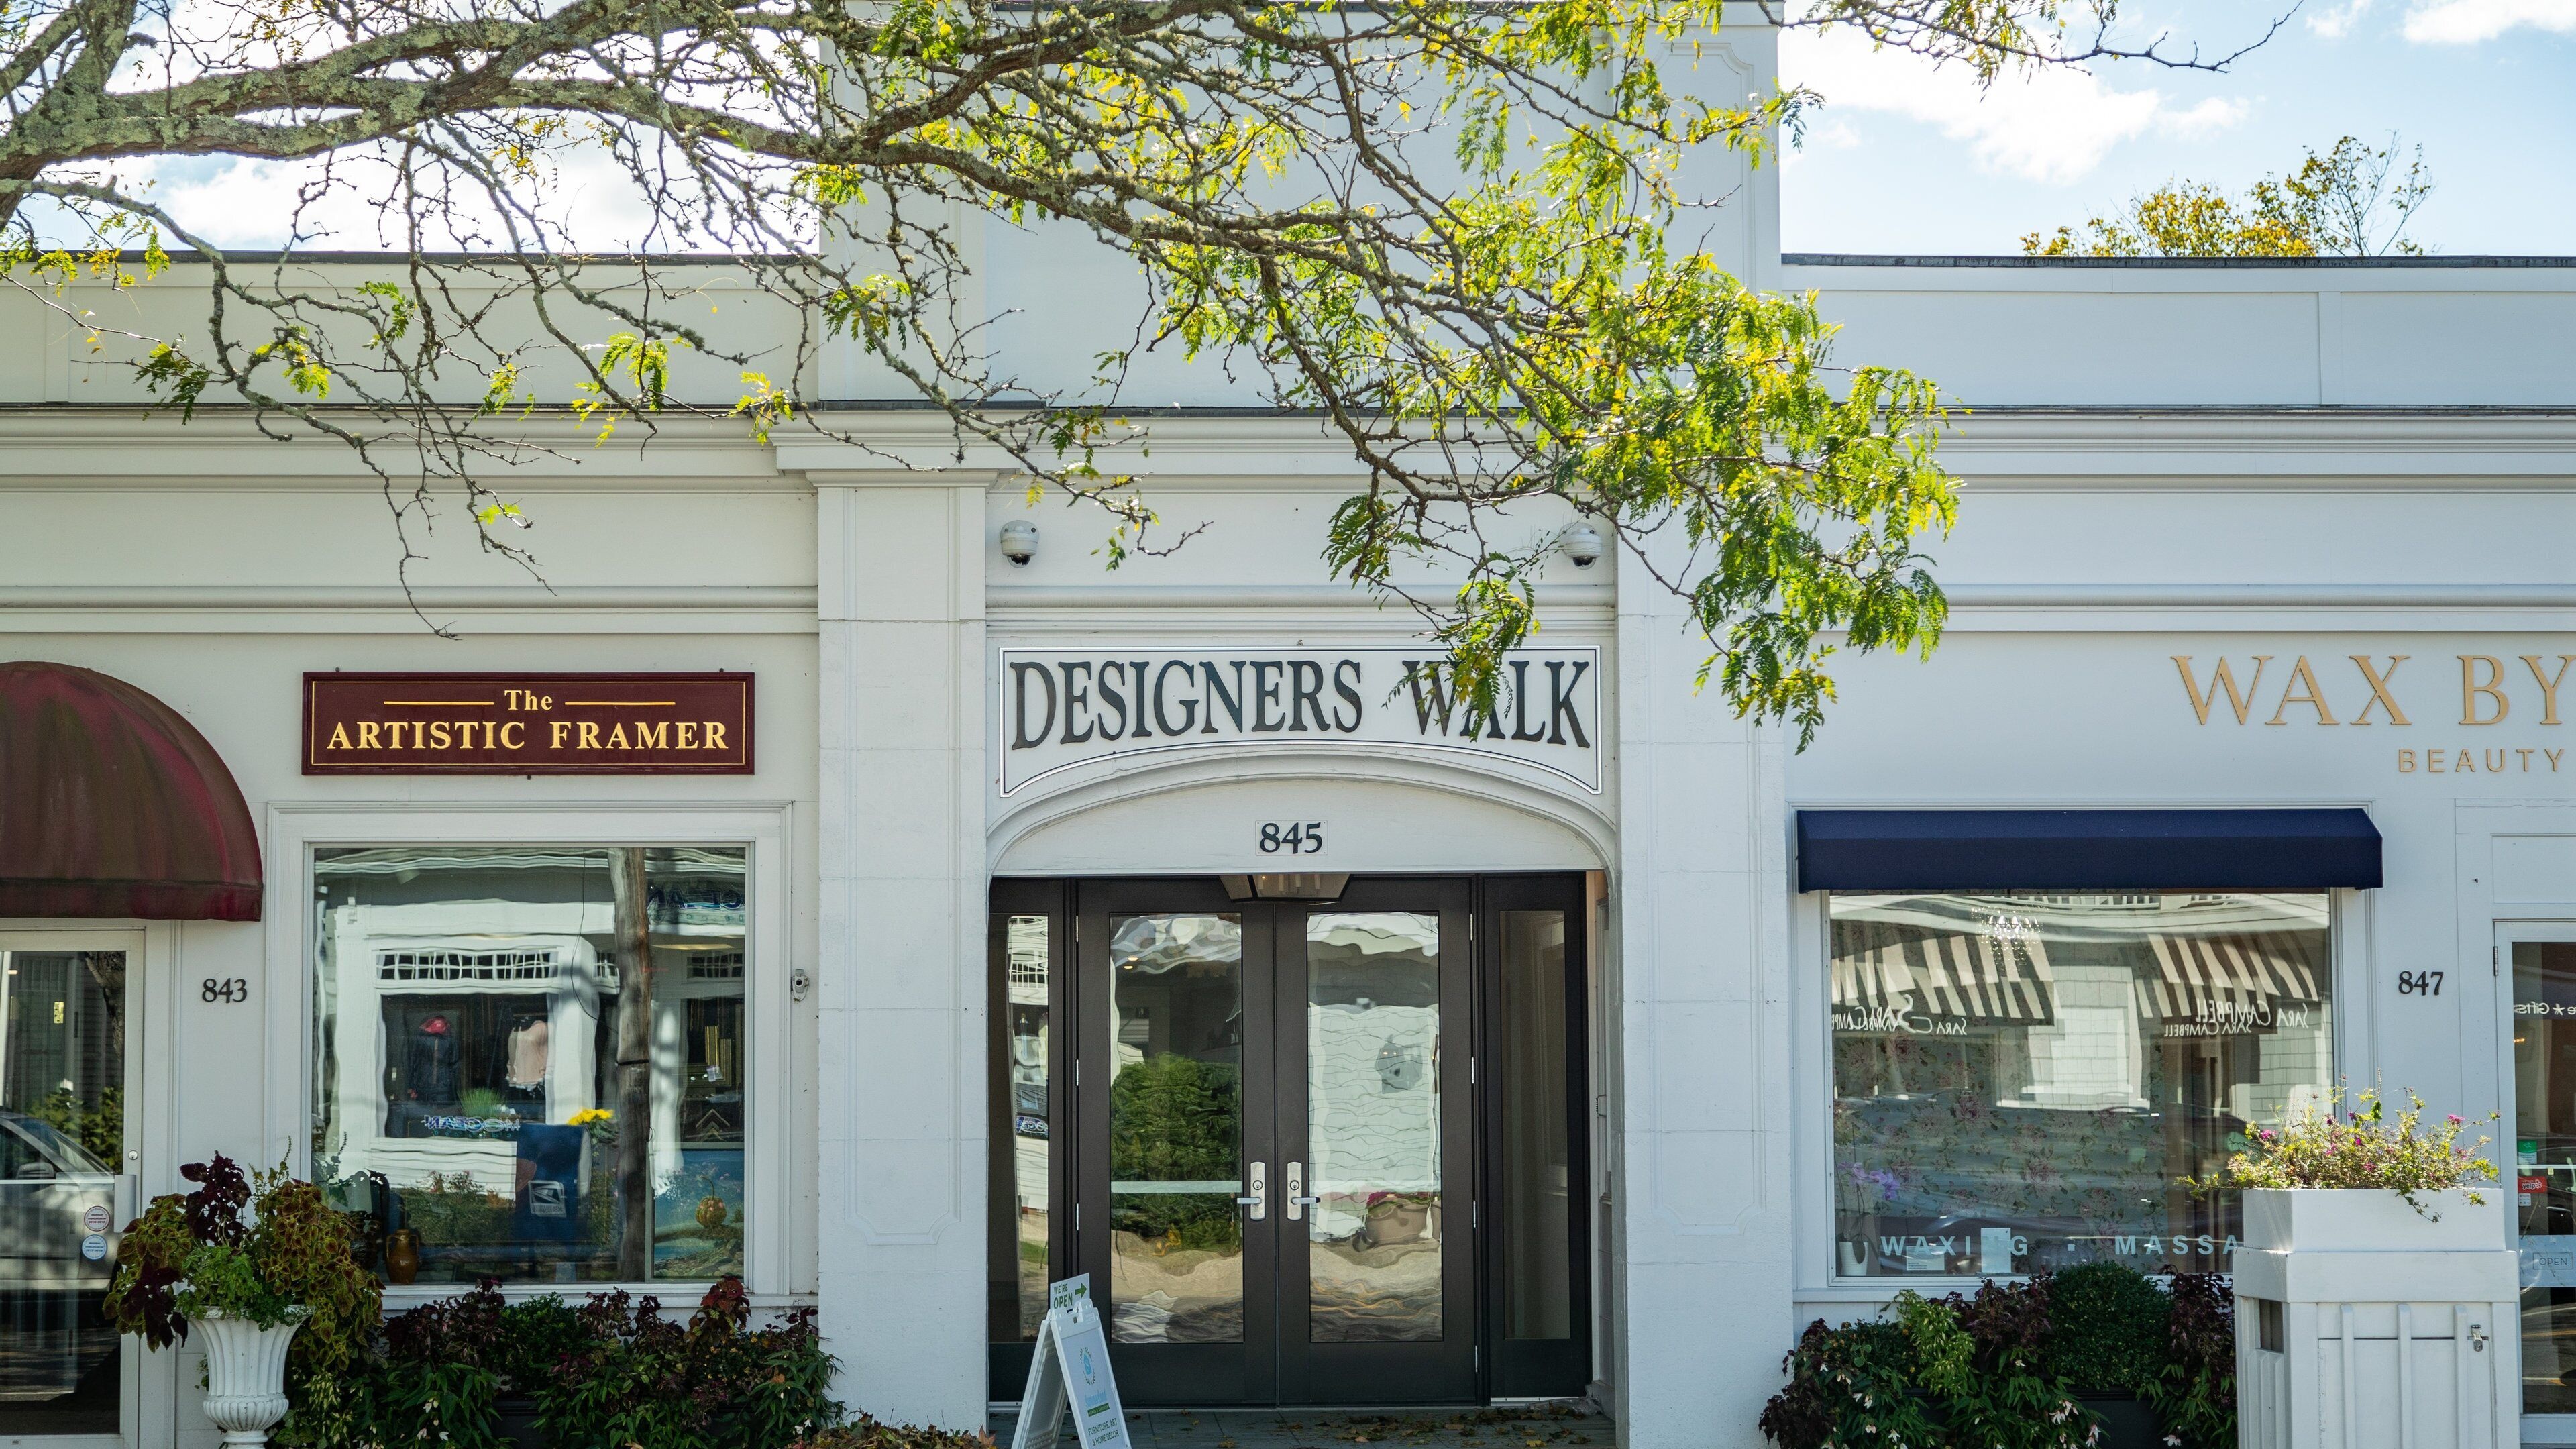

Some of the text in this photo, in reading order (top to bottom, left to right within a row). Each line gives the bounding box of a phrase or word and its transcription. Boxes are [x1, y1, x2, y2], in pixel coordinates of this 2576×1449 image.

[504, 690, 553, 711] The
[2170, 655, 2576, 726] WAX BY
[1010, 660, 1590, 751] DESIGNERS WALK
[327, 722, 729, 749] ARTISTIC FRAMER
[2398, 748, 2565, 773] BEAUTY
[1258, 822, 1323, 854] 845
[202, 977, 247, 1004] 843
[2398, 971, 2444, 996] 847
[2522, 1182, 2536, 1190] yelp
[1880, 1235, 2028, 1256] WAXIG
[2539, 1258, 2568, 1266] OPEN
[1054, 1283, 1068, 1295] WE'RE
[1053, 1293, 1073, 1309] OPEN
[1095, 1434, 1106, 1445] HOME
[1106, 1430, 1119, 1441] DECOR
